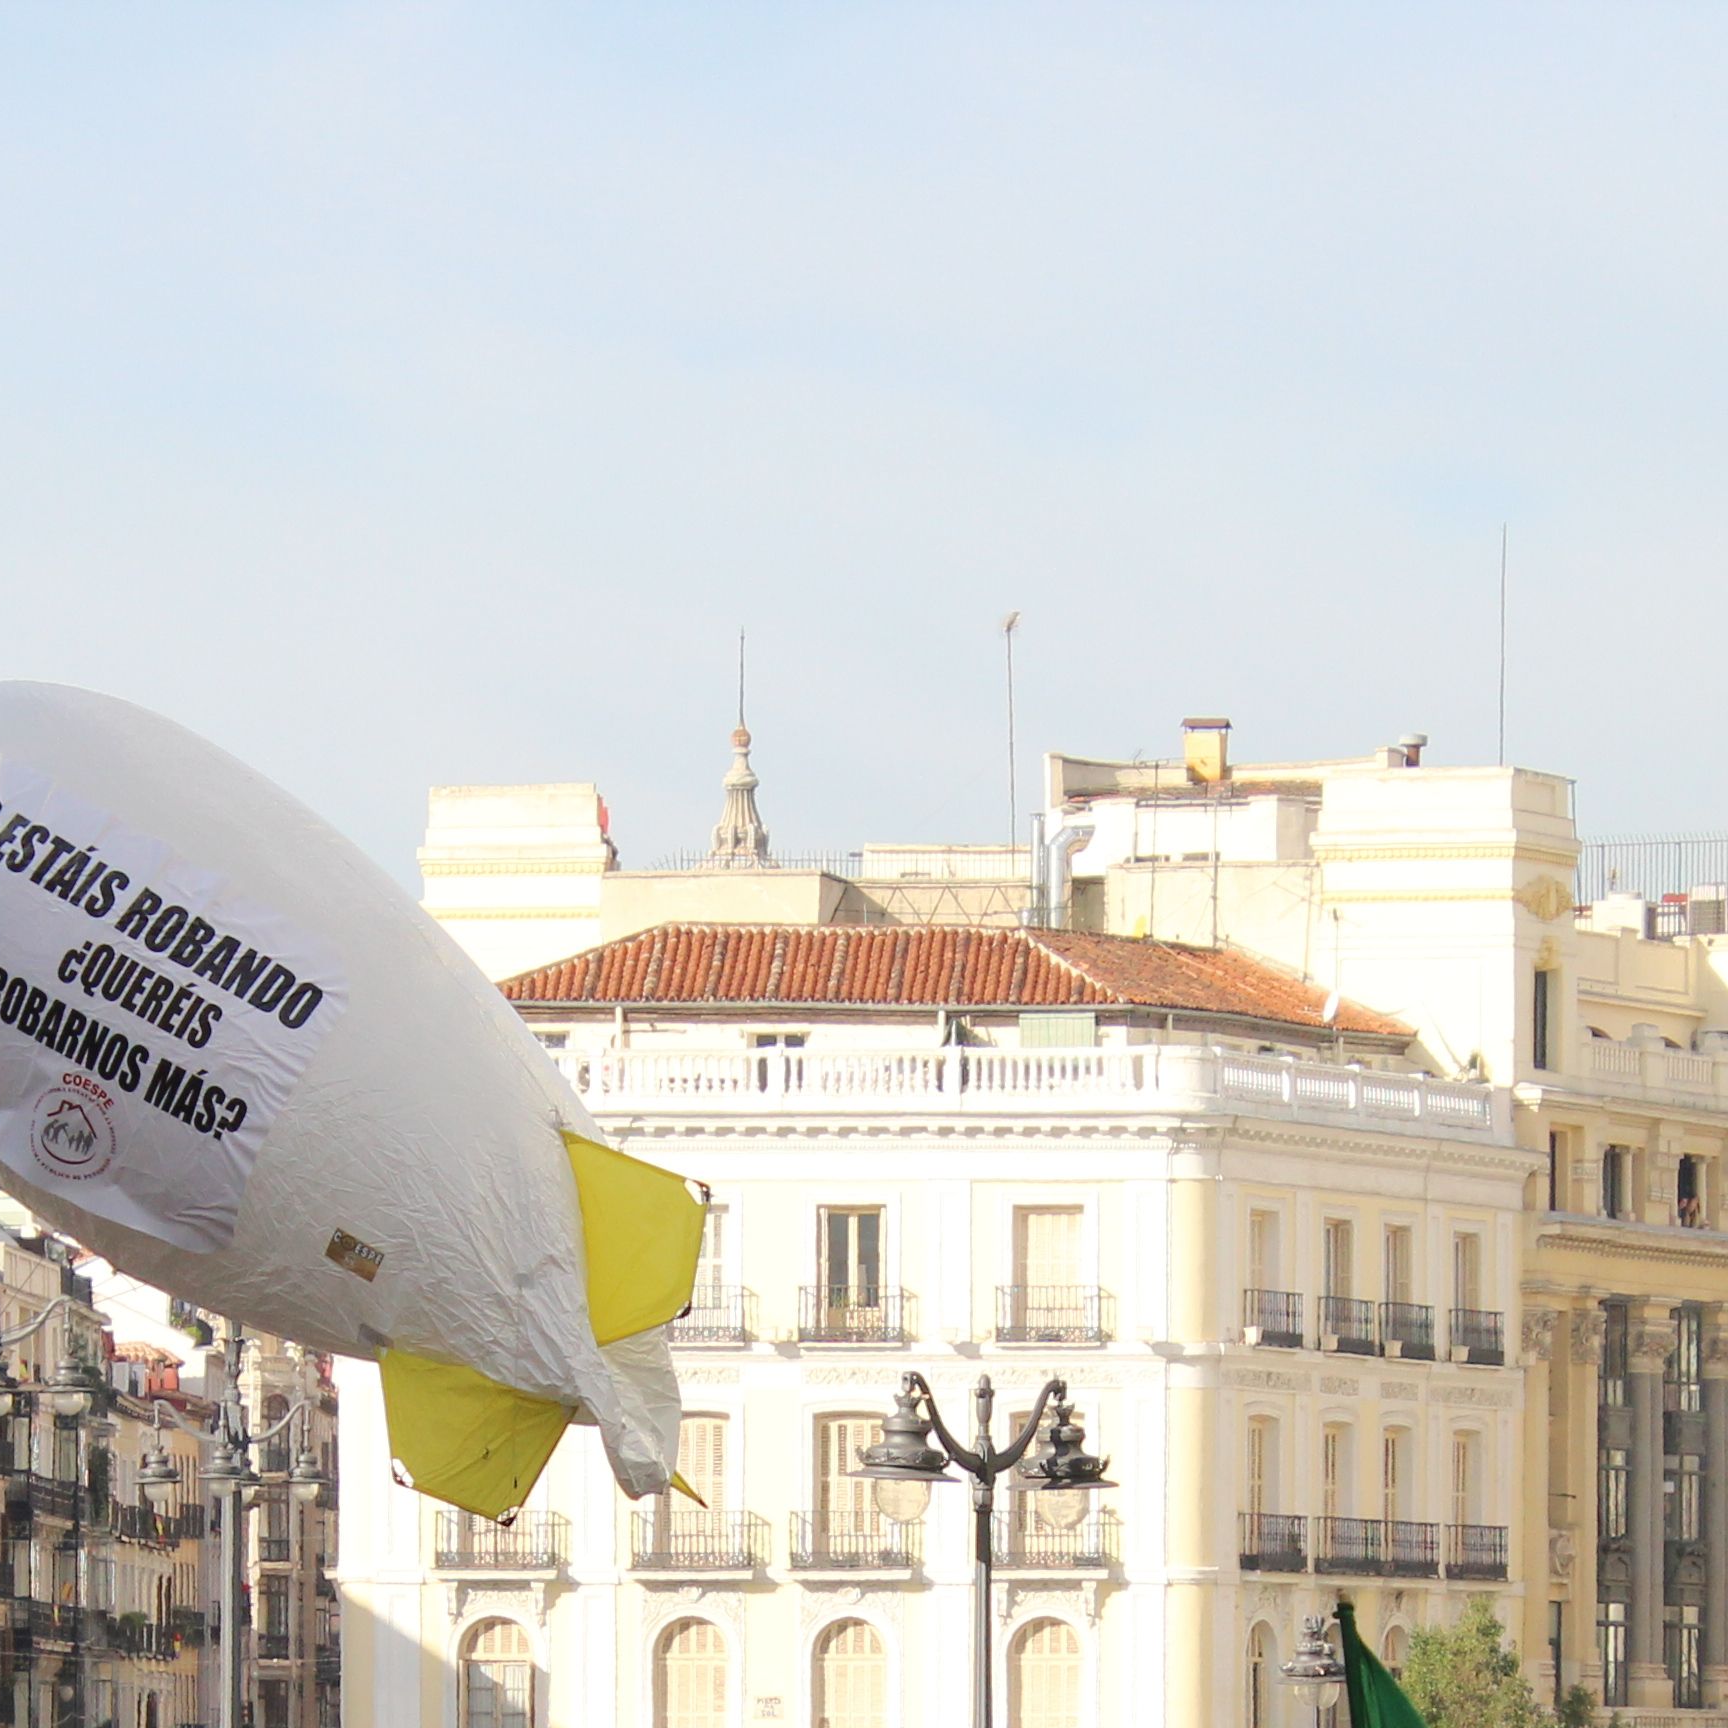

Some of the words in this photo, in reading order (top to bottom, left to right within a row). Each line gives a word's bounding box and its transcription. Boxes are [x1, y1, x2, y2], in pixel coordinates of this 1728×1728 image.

[58, 943, 223, 1050] ¿QUERÉIS
[115, 886, 325, 1030] ROBANDO
[62, 1072, 114, 1109] COESPE
[144, 1058, 247, 1142] MÁS?
